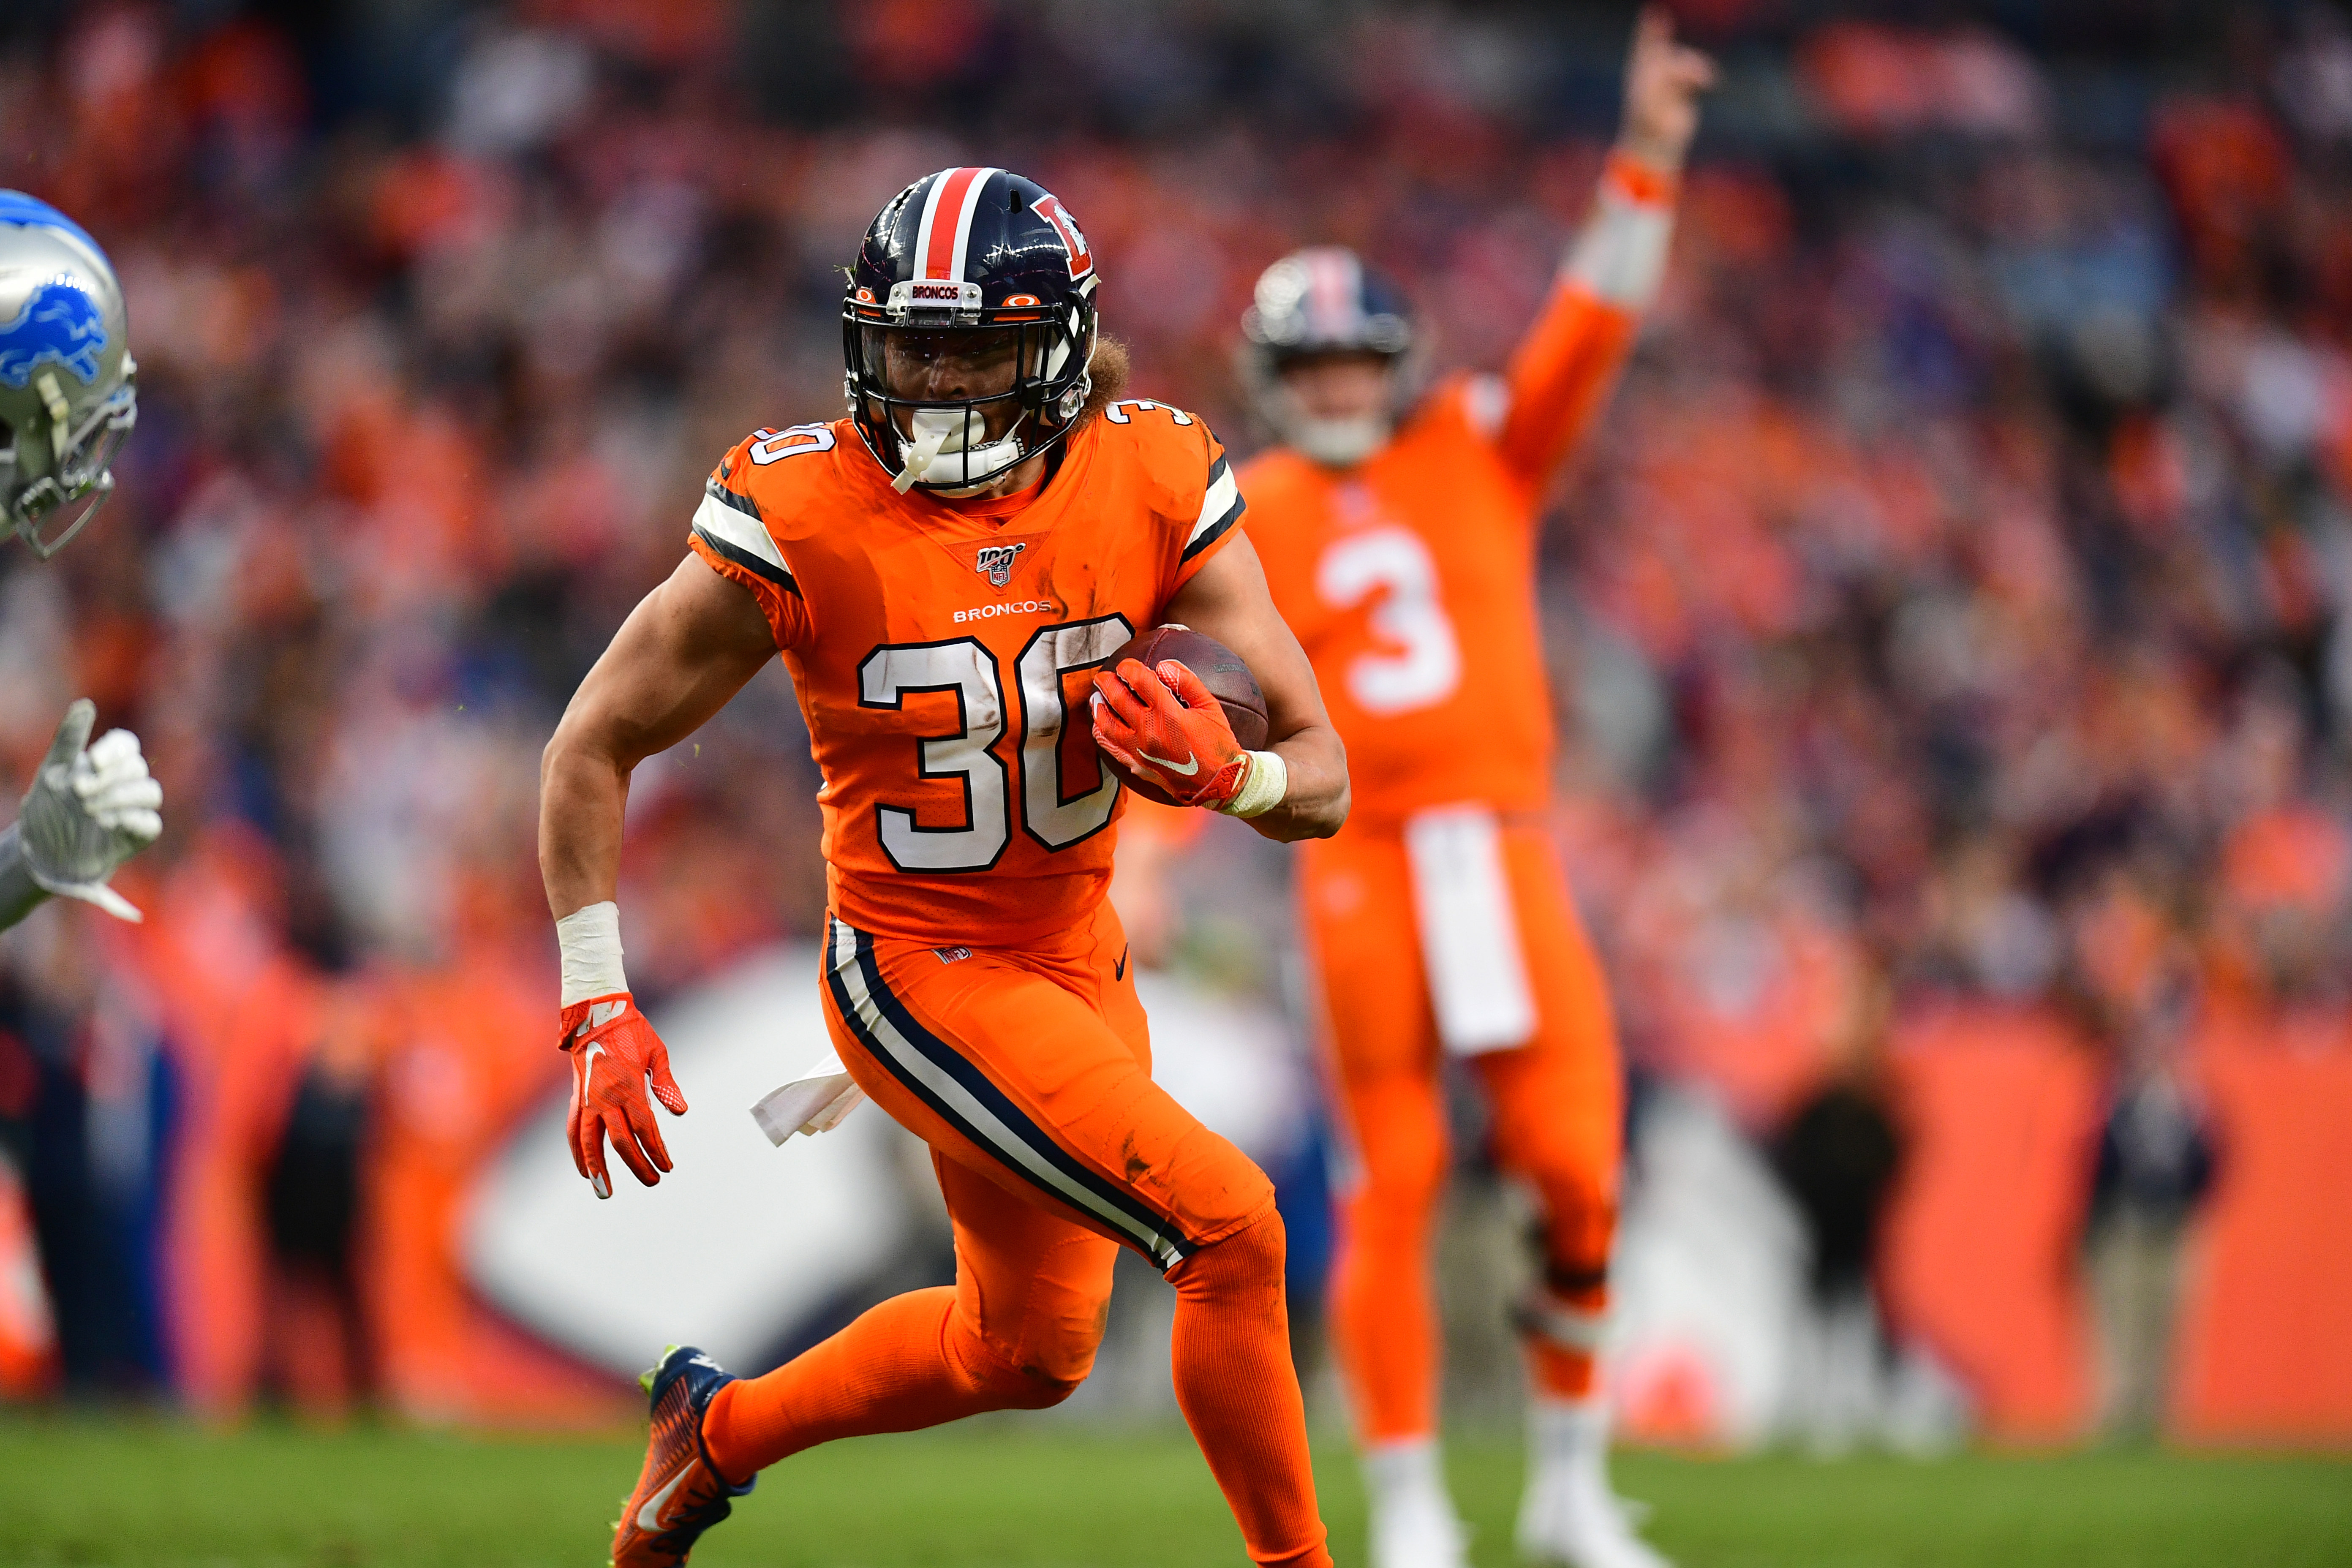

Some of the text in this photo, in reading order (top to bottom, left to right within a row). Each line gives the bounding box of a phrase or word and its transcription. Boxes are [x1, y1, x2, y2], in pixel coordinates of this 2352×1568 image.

[912, 286, 958, 299] BRONCOS
[994, 572, 1007, 582] NFL
[953, 600, 1052, 623] BRONCOS
[1316, 529, 1459, 714] 3
[857, 612, 1136, 874] 30
[943, 948, 968, 962] NFL
